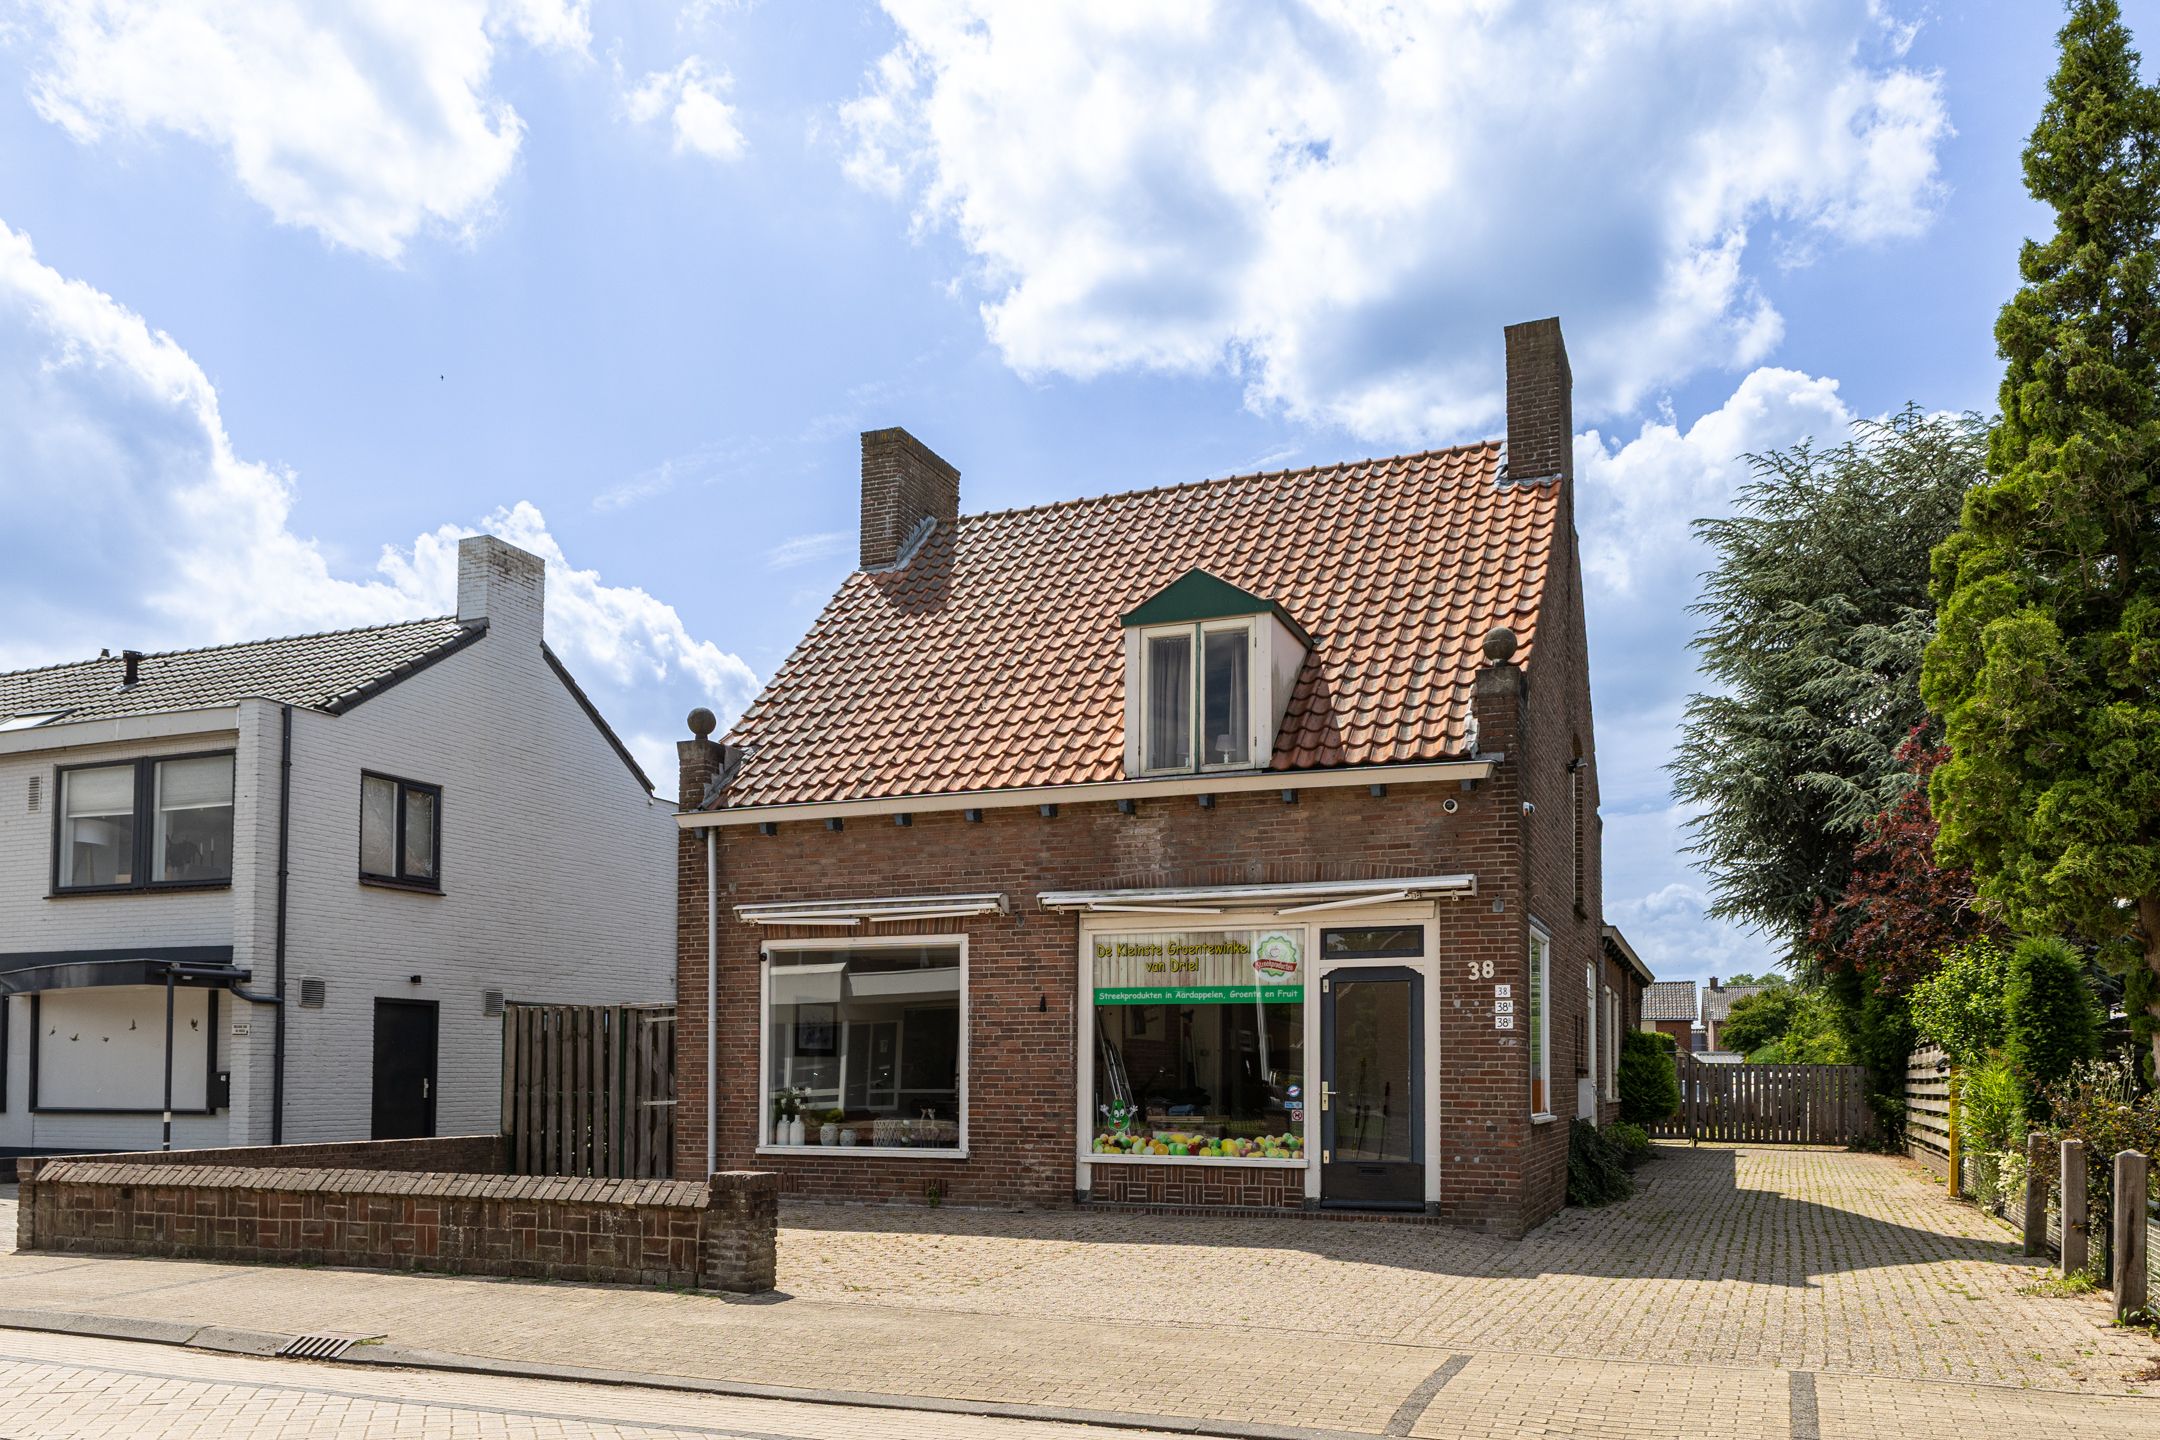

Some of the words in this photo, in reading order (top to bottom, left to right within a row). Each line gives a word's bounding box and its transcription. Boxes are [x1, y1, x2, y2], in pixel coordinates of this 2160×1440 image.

[1096, 944, 1112, 958] De
[1116, 943, 1163, 957] Kleinste
[1167, 940, 1251, 955] Groentewinkel
[1146, 961, 1166, 973] van
[1170, 956, 1199, 973] Driel
[1467, 960, 1495, 980] 38
[1099, 991, 1162, 1002] Streekprodukten
[1165, 991, 1173, 999] in
[1175, 990, 1226, 1001] Aardappelen,
[1277, 989, 1298, 998] Fruit
[1498, 987, 1508, 996] 38
